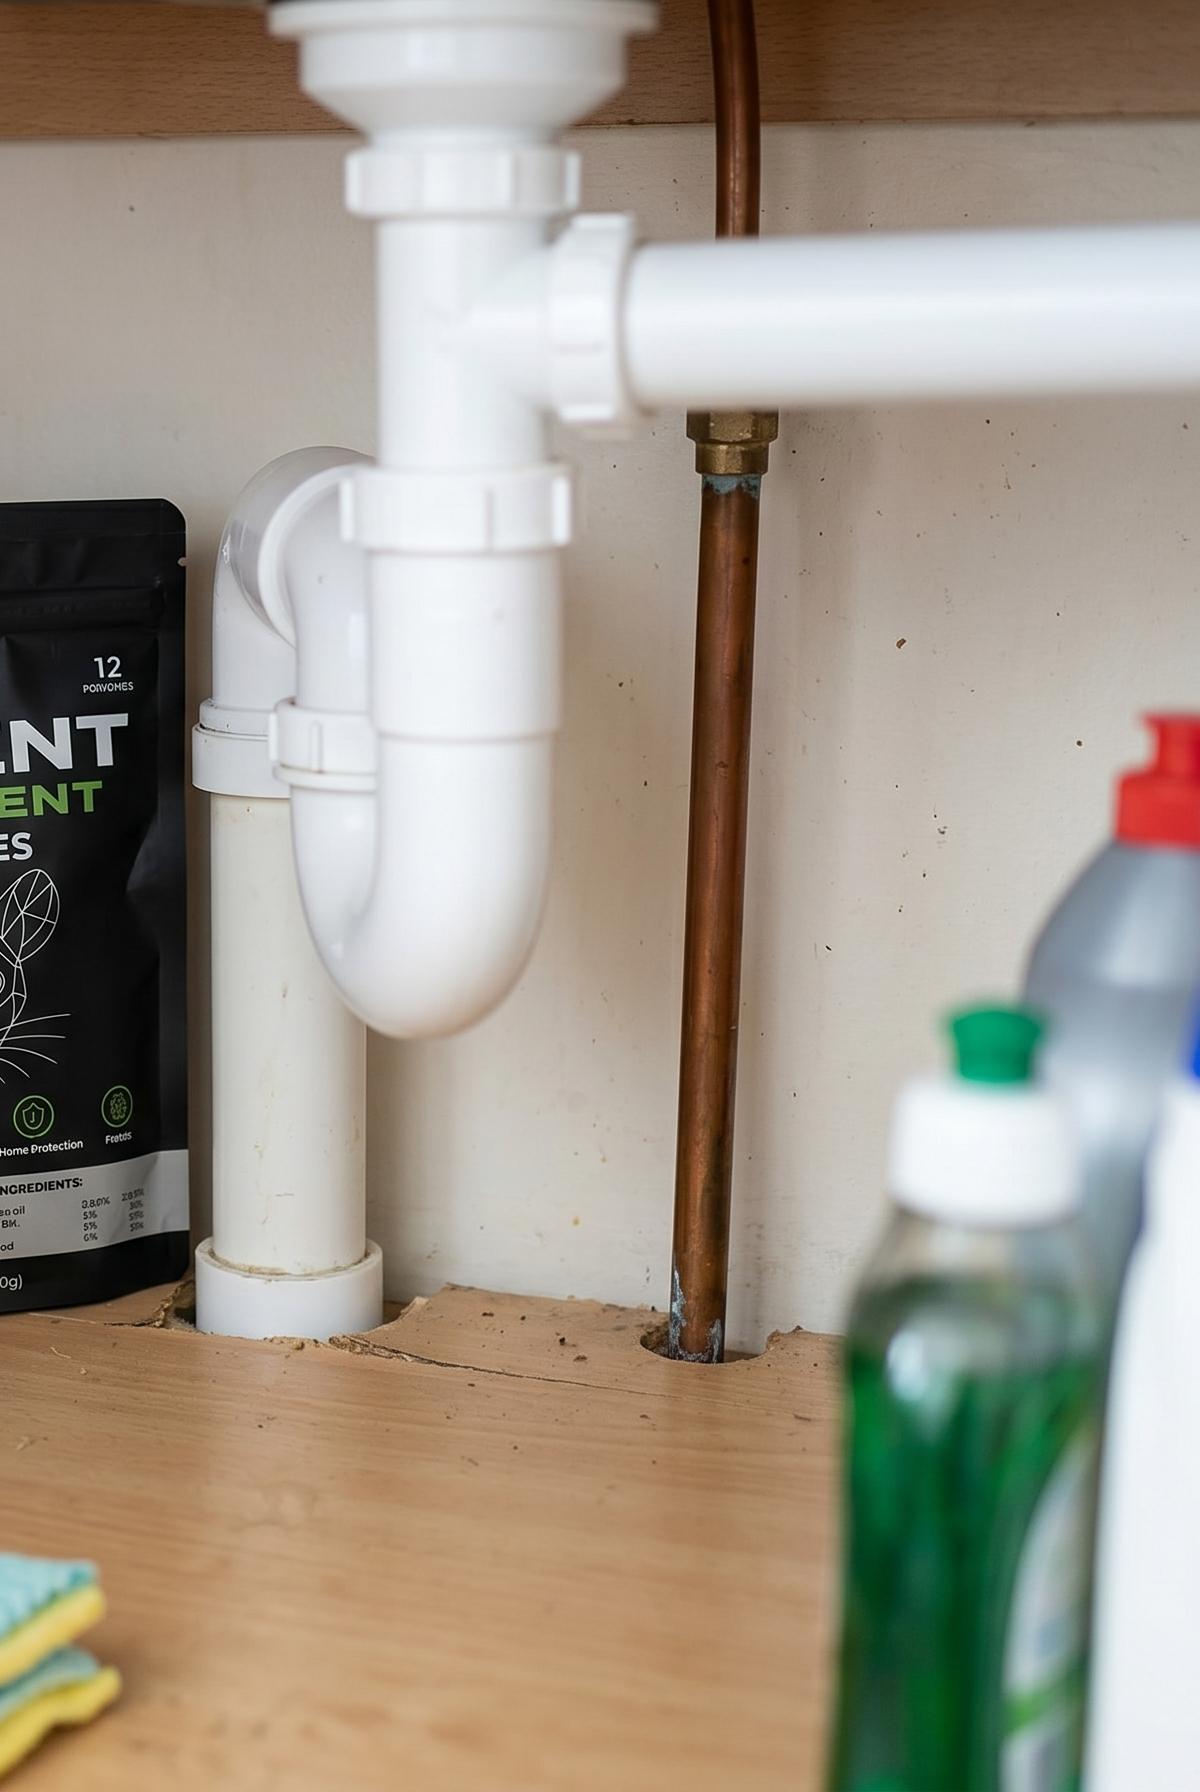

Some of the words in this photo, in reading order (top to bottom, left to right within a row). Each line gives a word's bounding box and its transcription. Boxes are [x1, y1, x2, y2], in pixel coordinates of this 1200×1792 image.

[94, 656, 122, 678] 12
[0, 1146, 29, 1157] Home
[31, 1139, 84, 1154] Protection
[12, 1205, 26, 1216] oil
